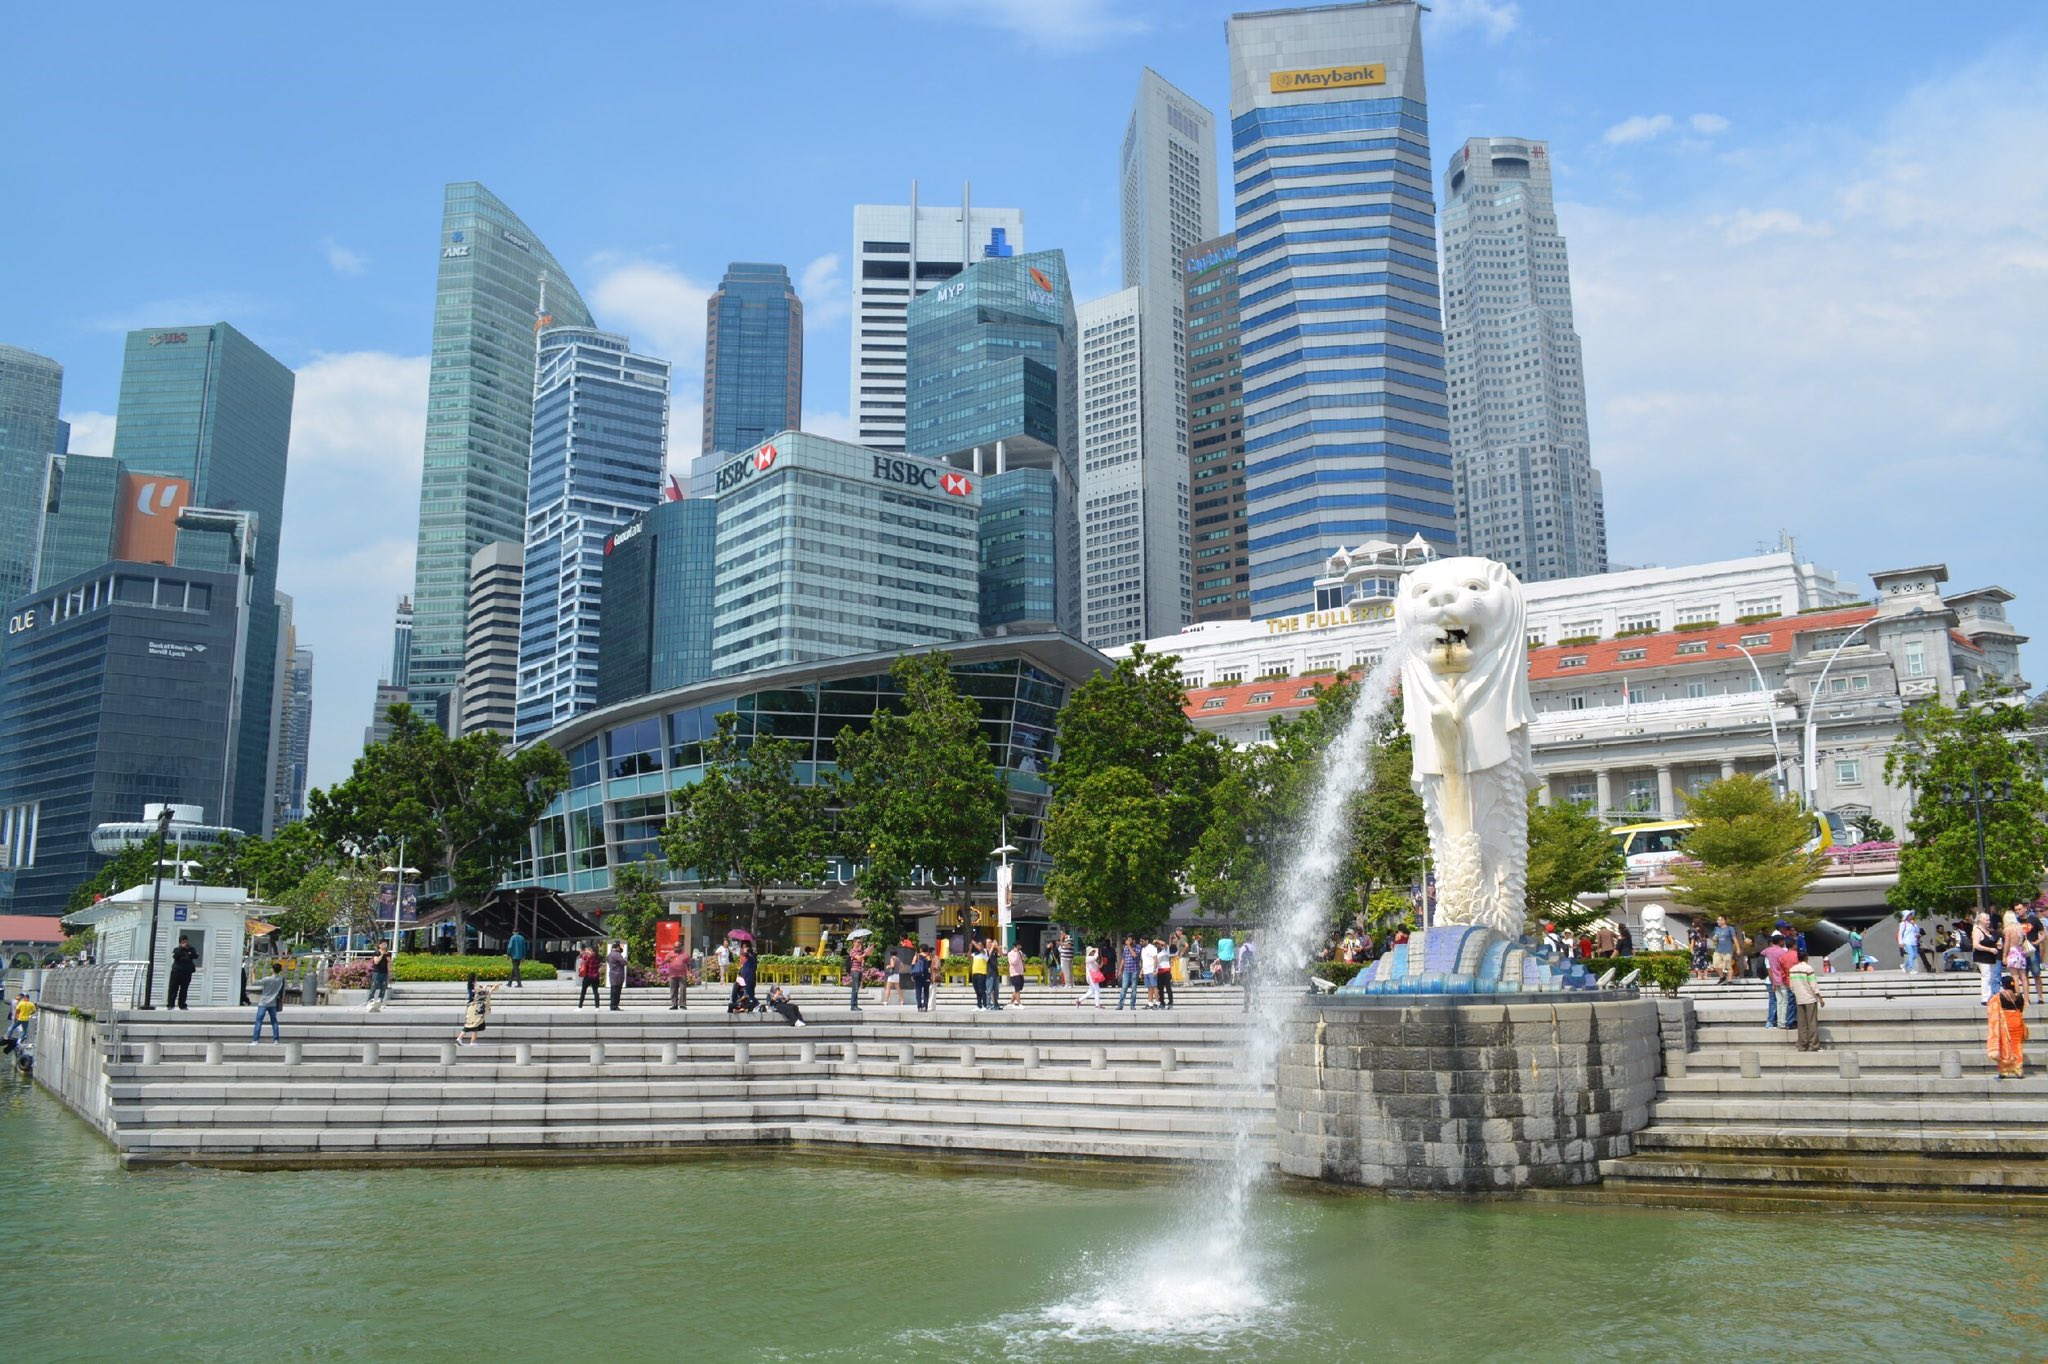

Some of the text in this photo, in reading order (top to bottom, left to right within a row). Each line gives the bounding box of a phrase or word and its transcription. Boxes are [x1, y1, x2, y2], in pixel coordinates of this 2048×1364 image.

[1294, 67, 1375, 86] Maybank
[443, 246, 470, 258] ANZ
[938, 282, 965, 302] MYP
[1026, 289, 1055, 306] MYP
[715, 453, 753, 493] HSBC
[873, 455, 937, 490] HSBC
[9, 609, 35, 634] OUE
[1266, 601, 1396, 634] THE FULLERTO
